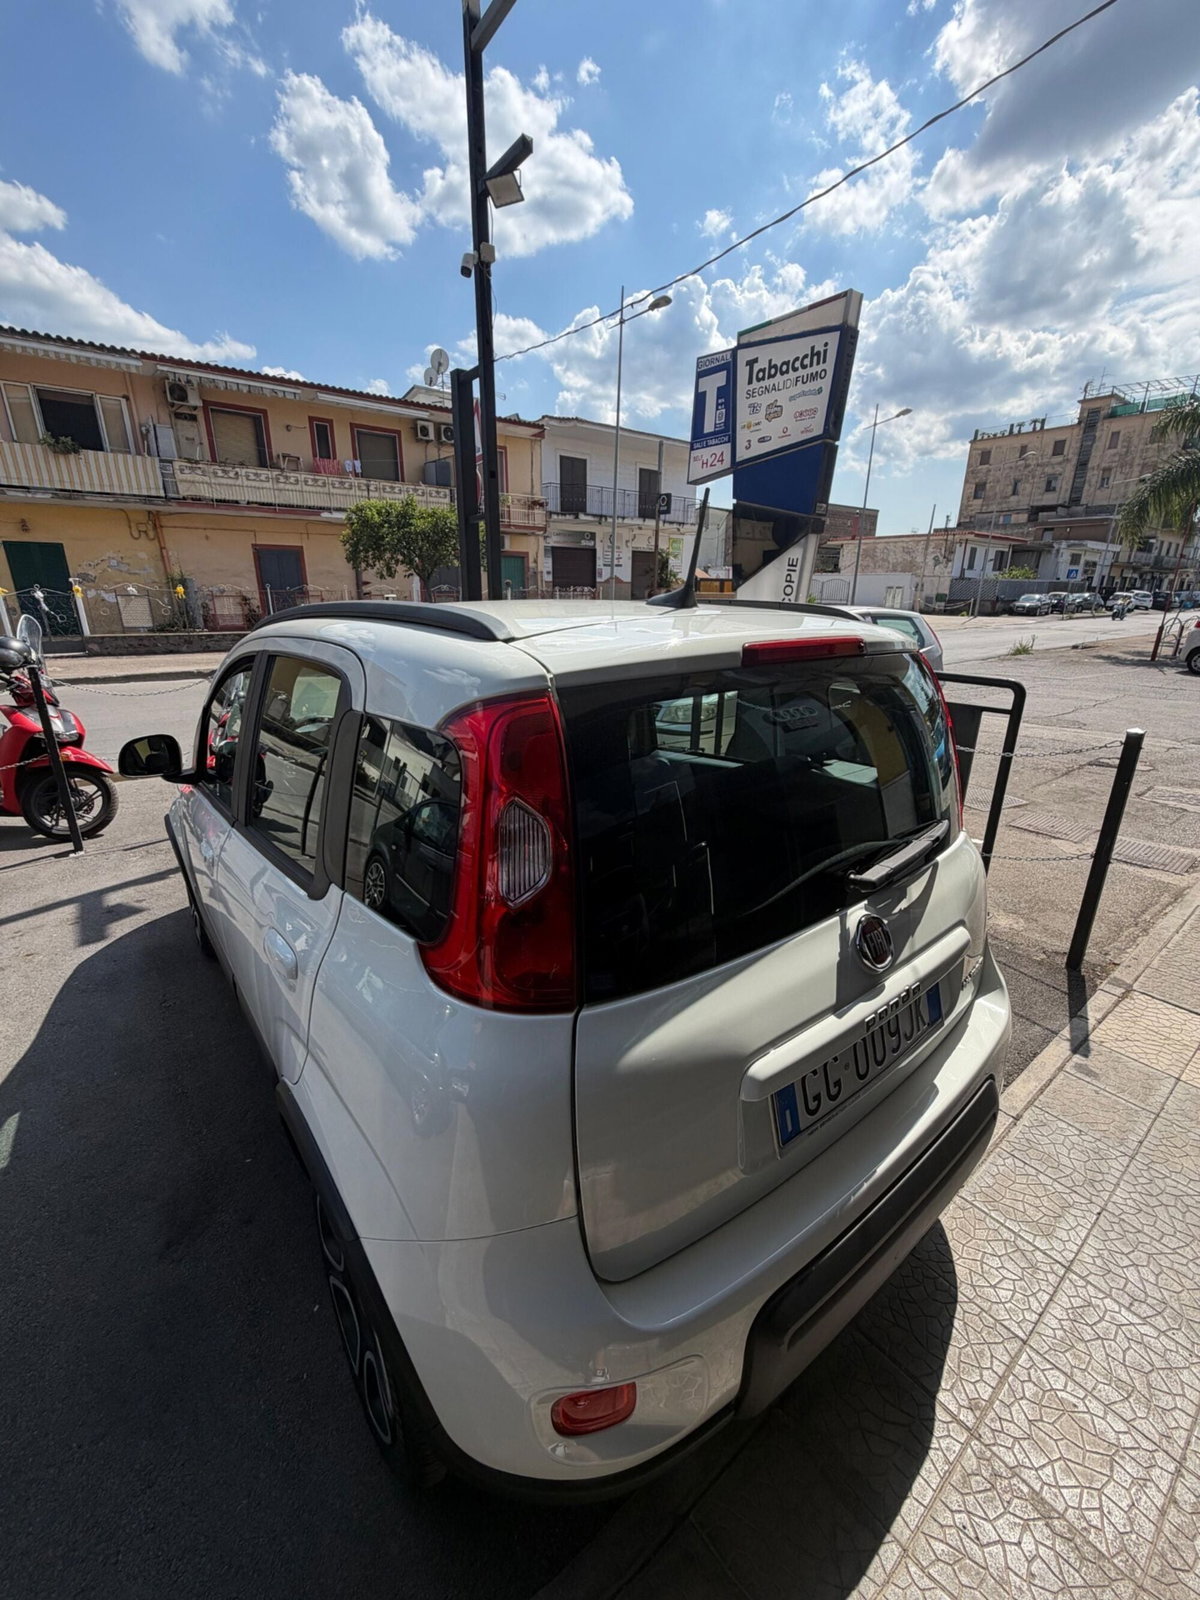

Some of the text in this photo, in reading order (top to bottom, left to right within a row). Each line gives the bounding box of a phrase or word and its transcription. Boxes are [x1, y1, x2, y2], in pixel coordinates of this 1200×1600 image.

[697, 352, 732, 370] GIORNALI
[745, 342, 829, 385] Tabacchi
[698, 370, 727, 434] T
[745, 439, 752, 450] 3
